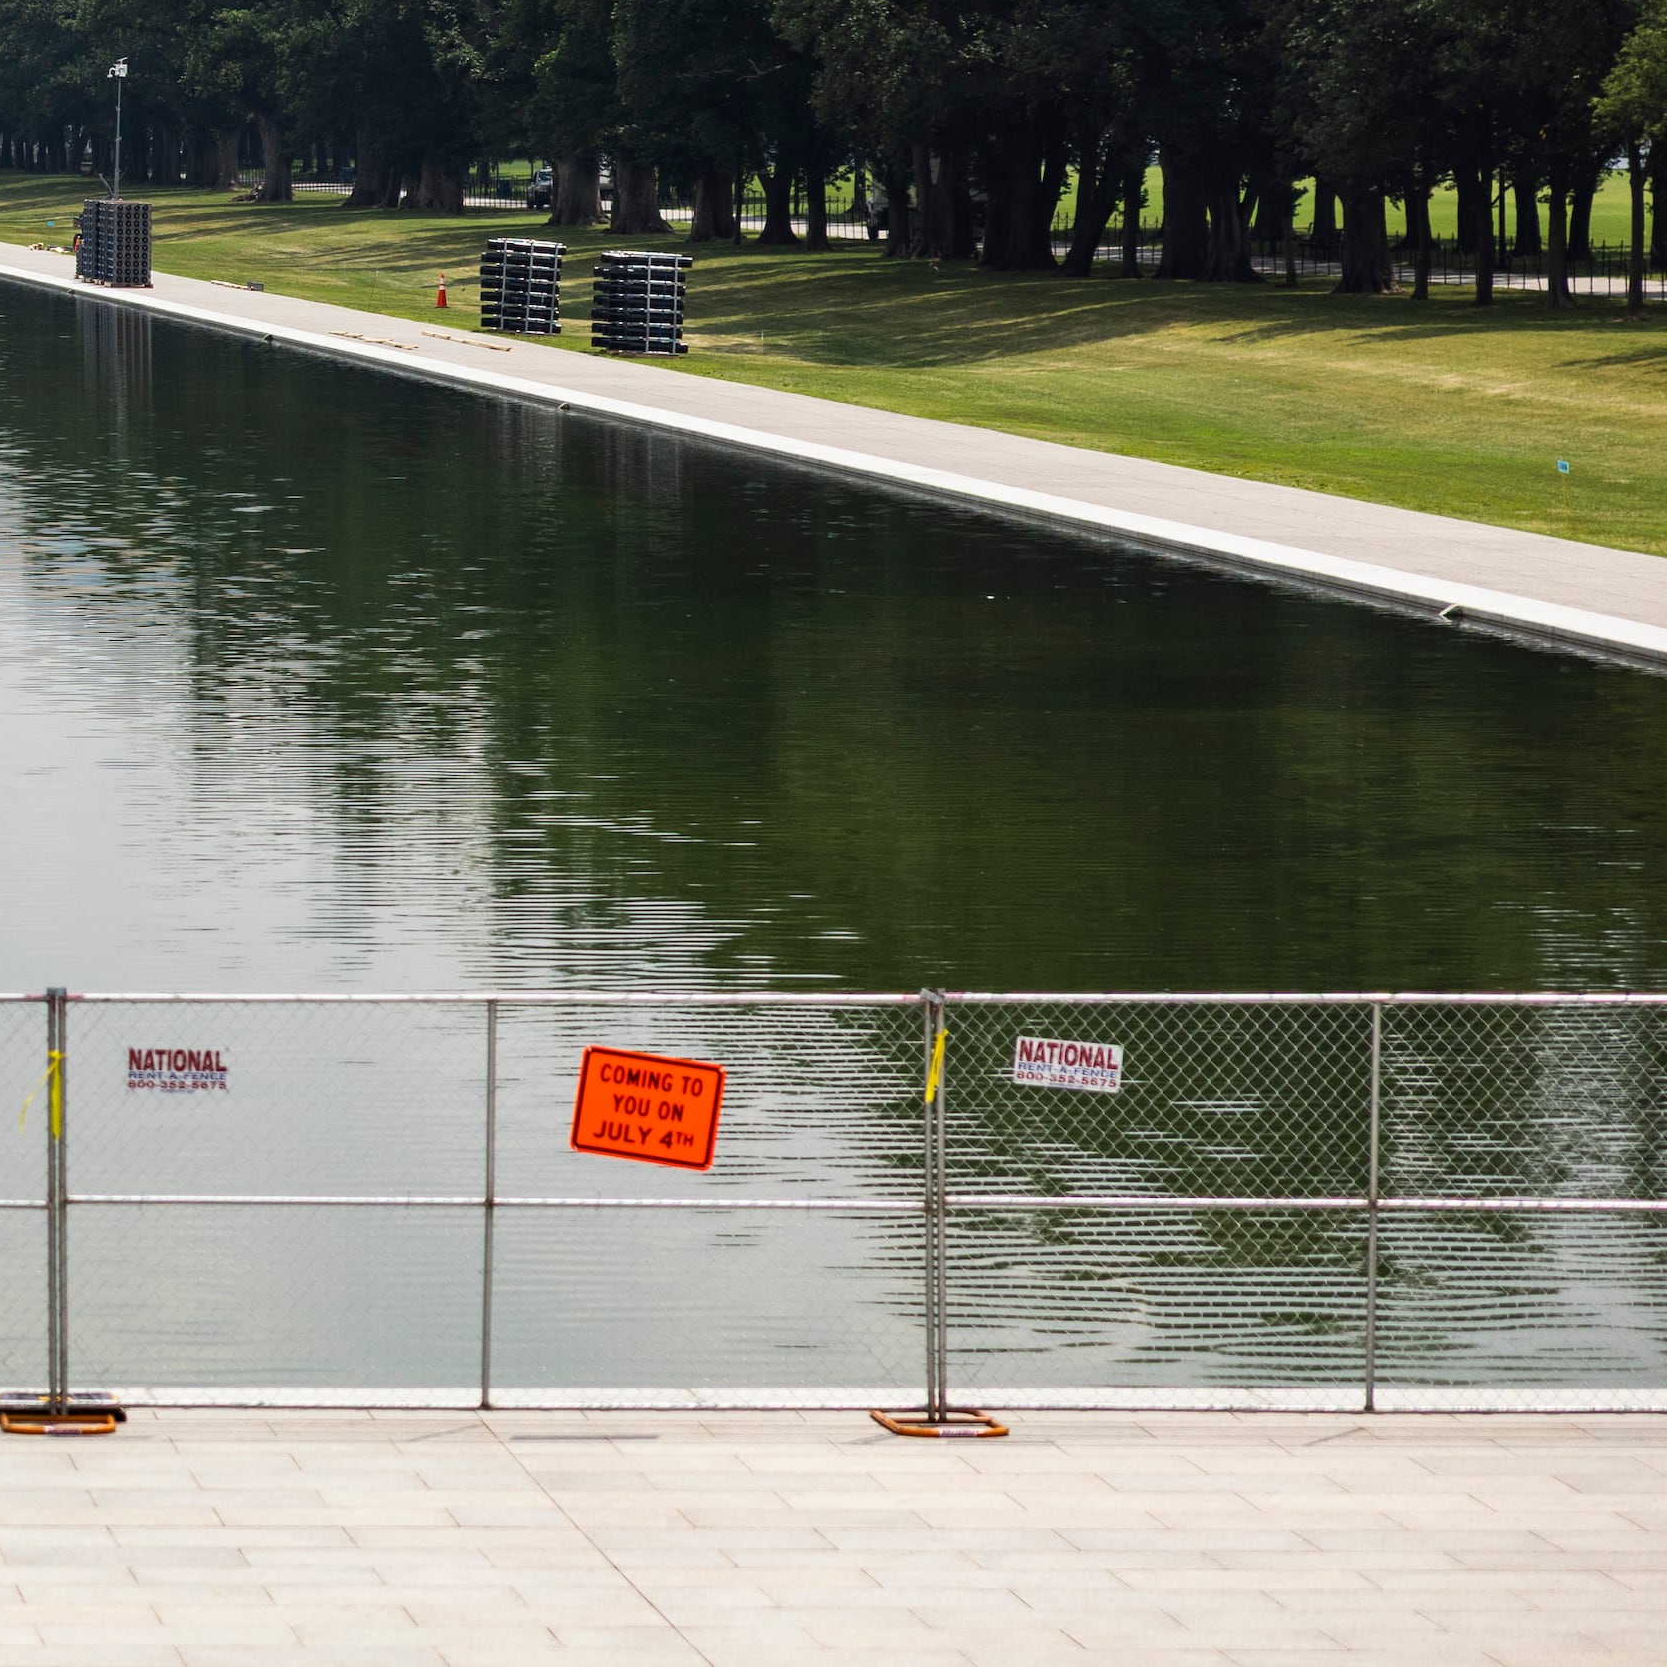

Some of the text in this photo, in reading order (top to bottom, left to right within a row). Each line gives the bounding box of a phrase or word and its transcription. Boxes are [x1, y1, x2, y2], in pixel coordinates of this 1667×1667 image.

[128, 1048, 228, 1071] NATIONAL
[1019, 1039, 1118, 1069] NATIONAL
[128, 1072, 227, 1080] RENT-A-FENCE
[599, 1063, 703, 1097] COMING TO
[1017, 1062, 1117, 1078] RENT-A-FENCE
[613, 1093, 684, 1122] YOU ON
[593, 1120, 694, 1149] JULY 4TH
